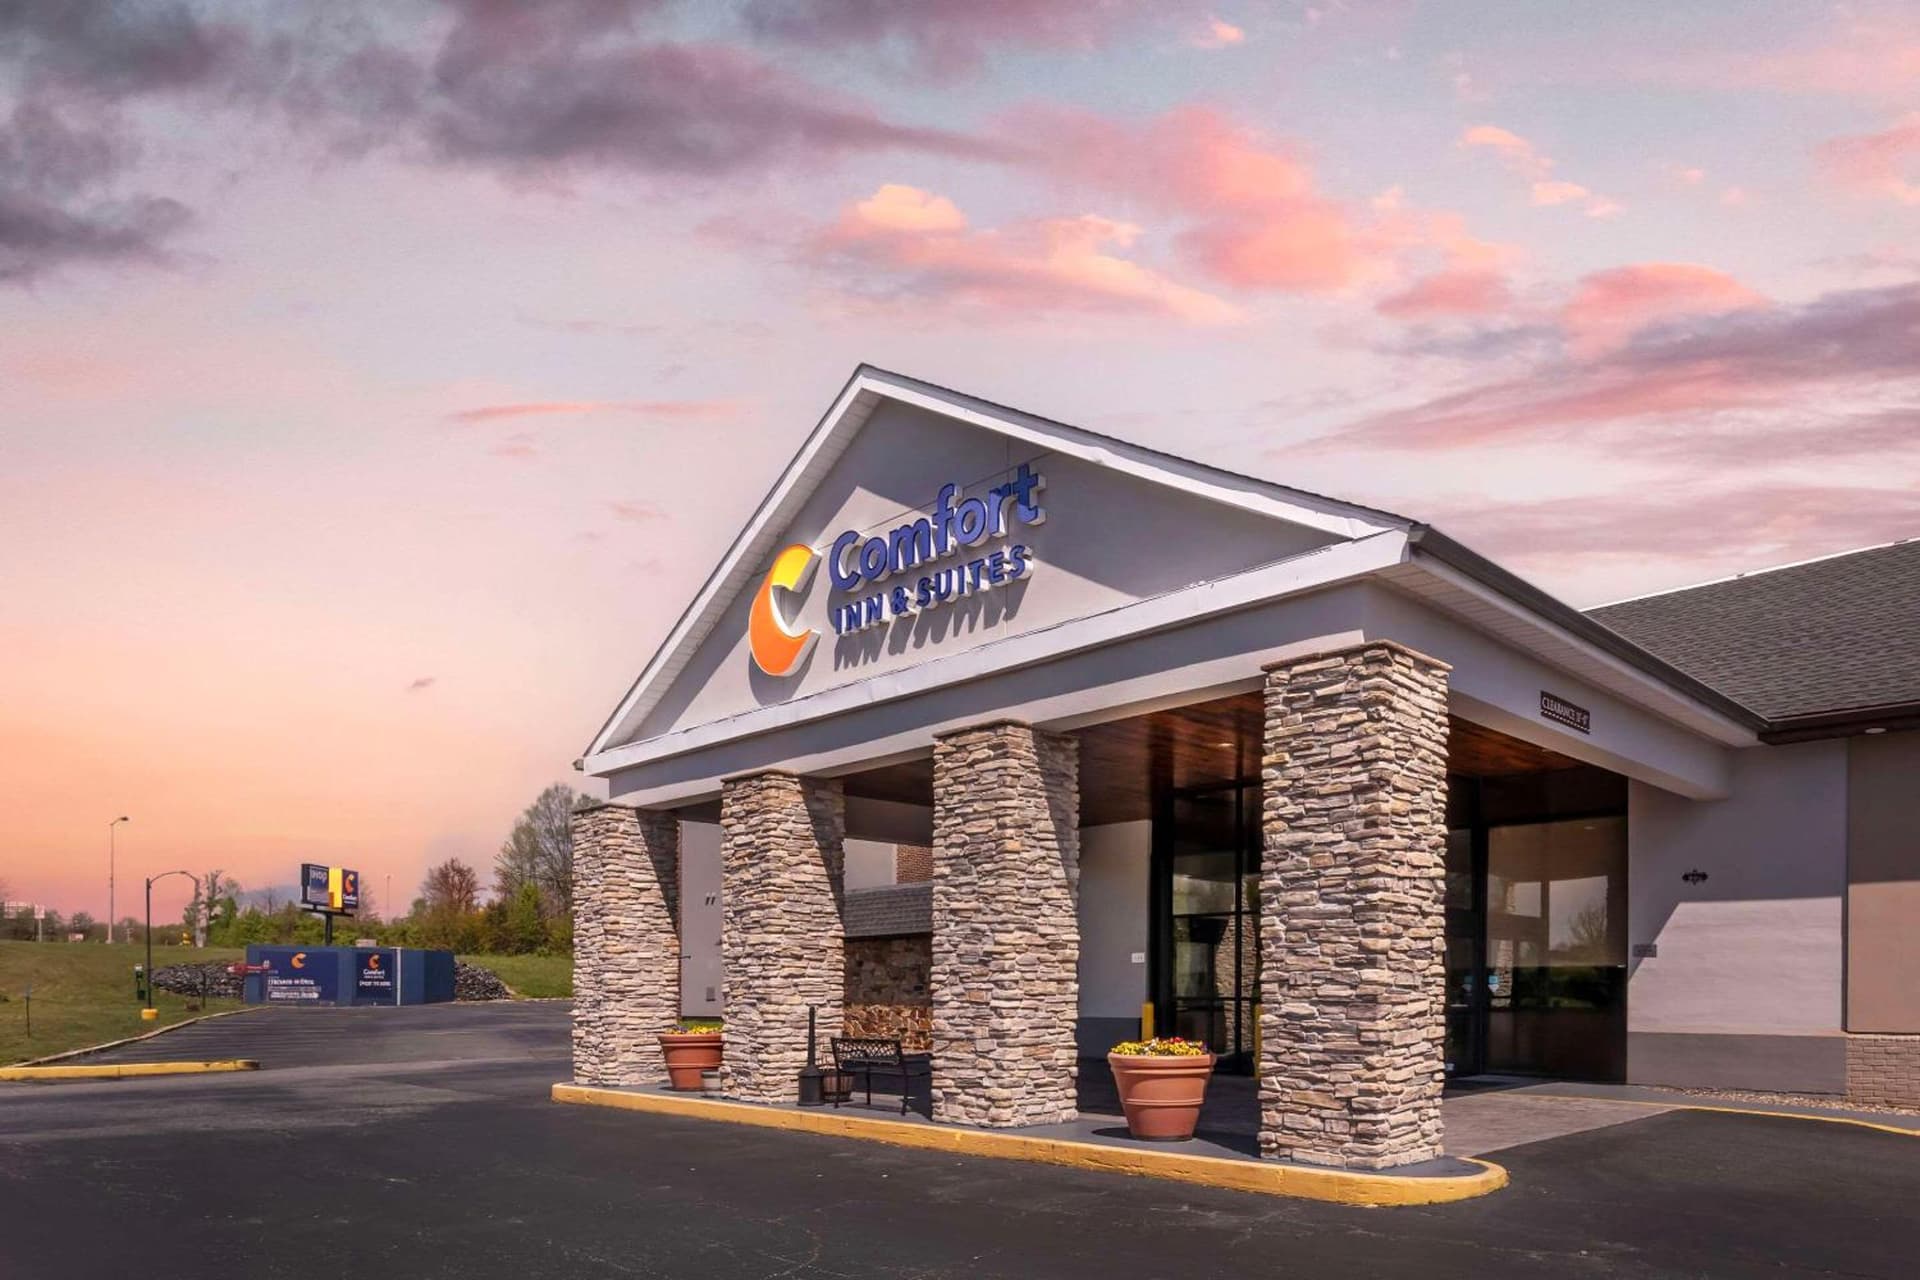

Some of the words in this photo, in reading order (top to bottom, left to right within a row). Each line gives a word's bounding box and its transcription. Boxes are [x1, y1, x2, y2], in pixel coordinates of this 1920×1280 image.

[829, 463, 1047, 590] Comfort
[834, 593, 888, 635] INN
[890, 588, 915, 616] &
[916, 544, 1035, 607] SUITES
